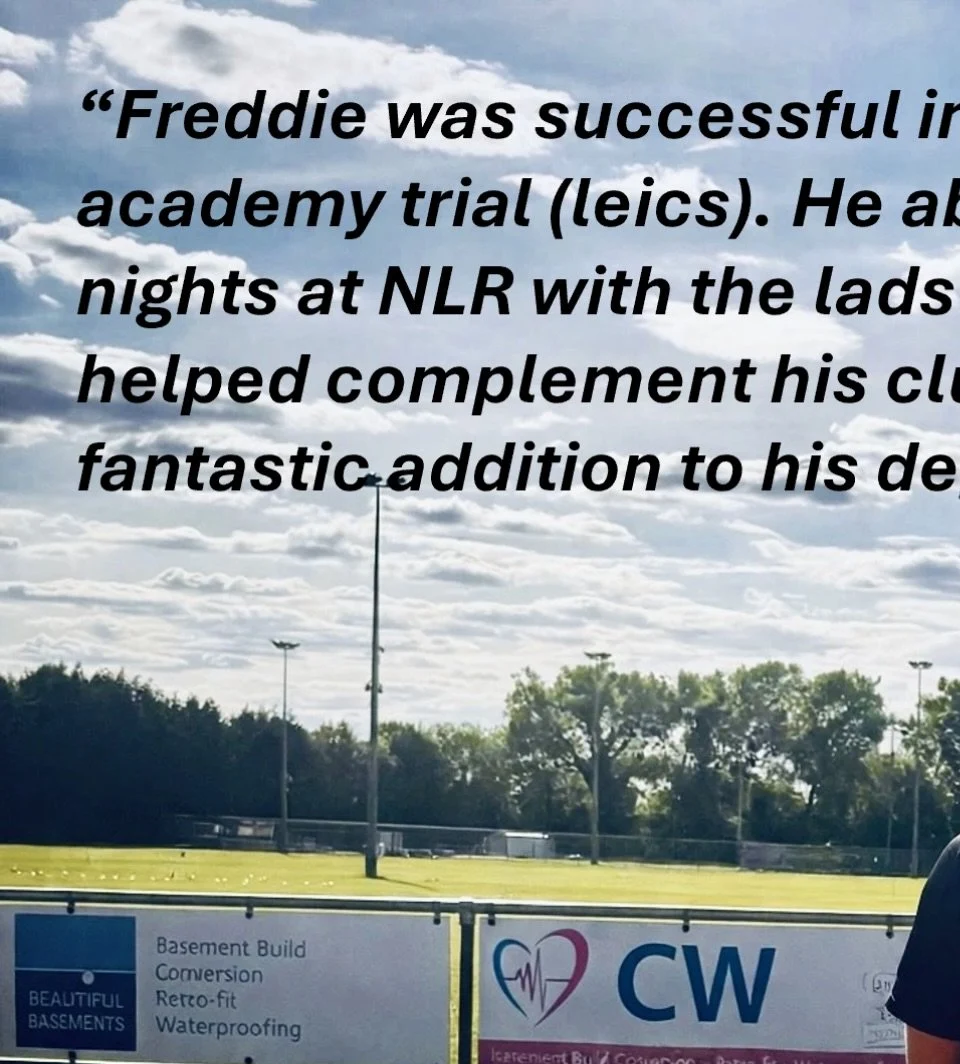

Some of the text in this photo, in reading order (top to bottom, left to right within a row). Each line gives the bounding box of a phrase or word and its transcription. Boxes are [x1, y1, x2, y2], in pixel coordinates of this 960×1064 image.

[156, 936, 306, 959] Basement Build
[617, 943, 776, 1024] CW
[29, 990, 125, 1009] BEAUTIFUL
[28, 1013, 126, 1032] BASEMENTS
[155, 1015, 302, 1043] Waterproofing
